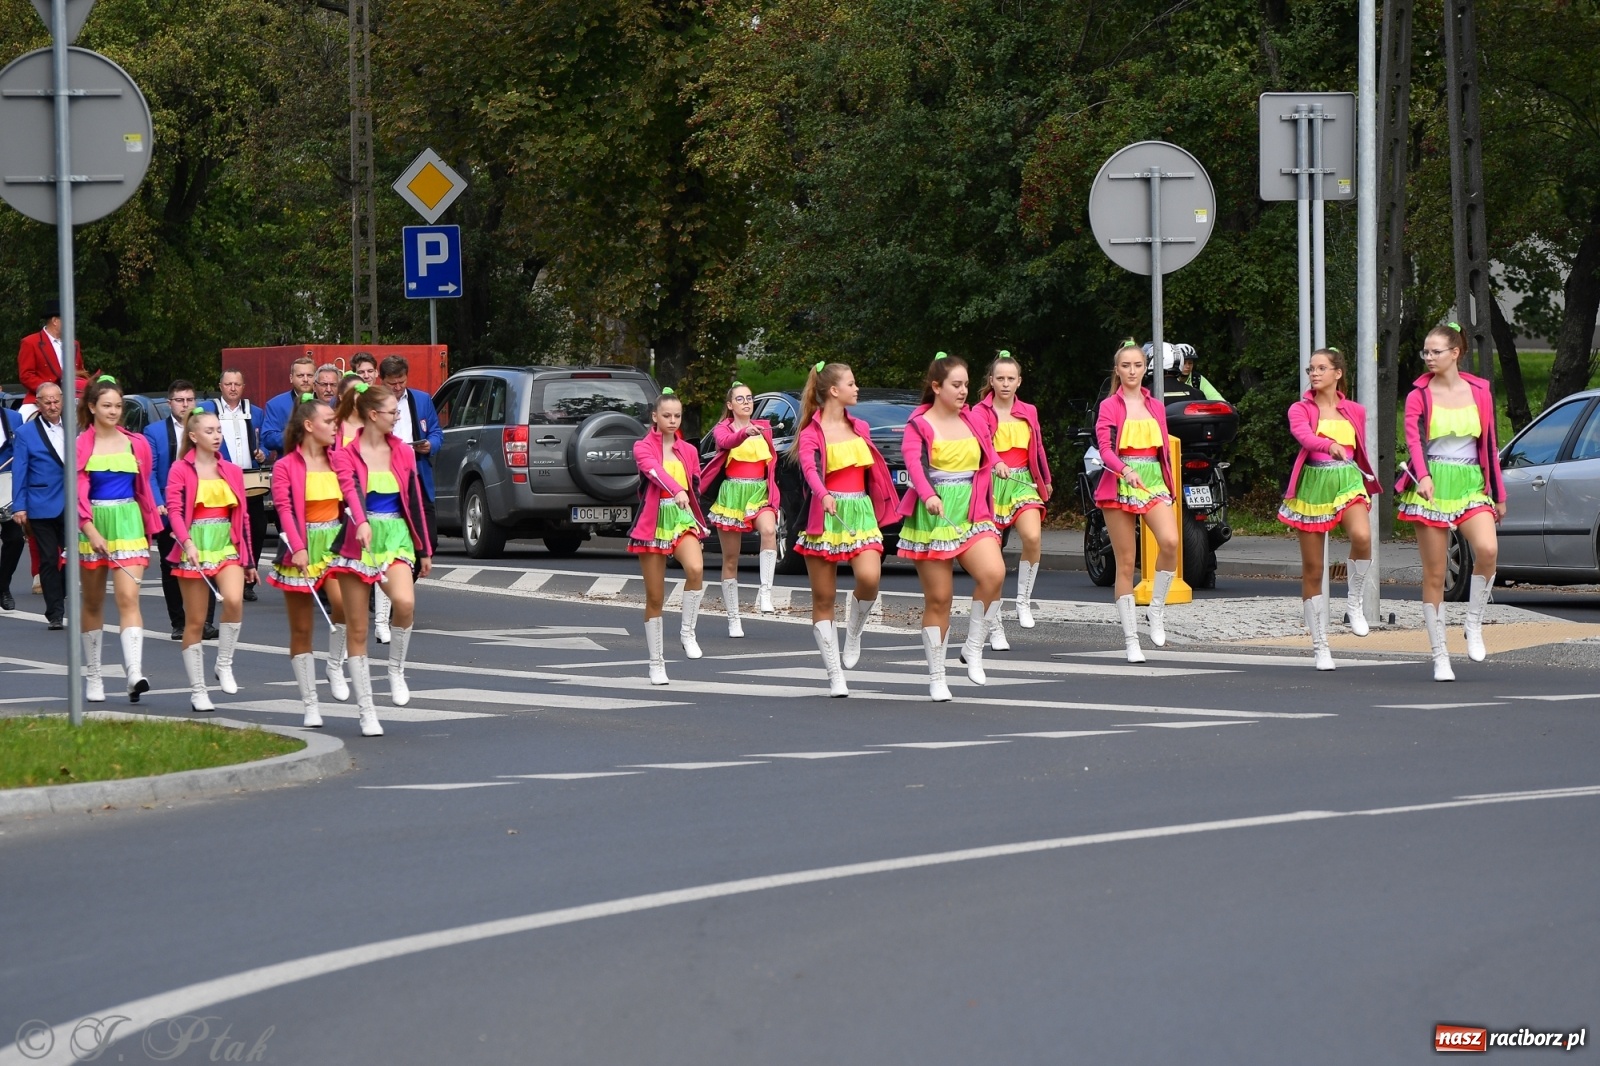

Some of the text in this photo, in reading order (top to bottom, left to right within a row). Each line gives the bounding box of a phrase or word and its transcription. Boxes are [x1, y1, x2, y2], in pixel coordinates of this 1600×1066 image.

[417, 232, 449, 277] P
[586, 450, 633, 461] SUZU
[579, 508, 600, 519] OGL
